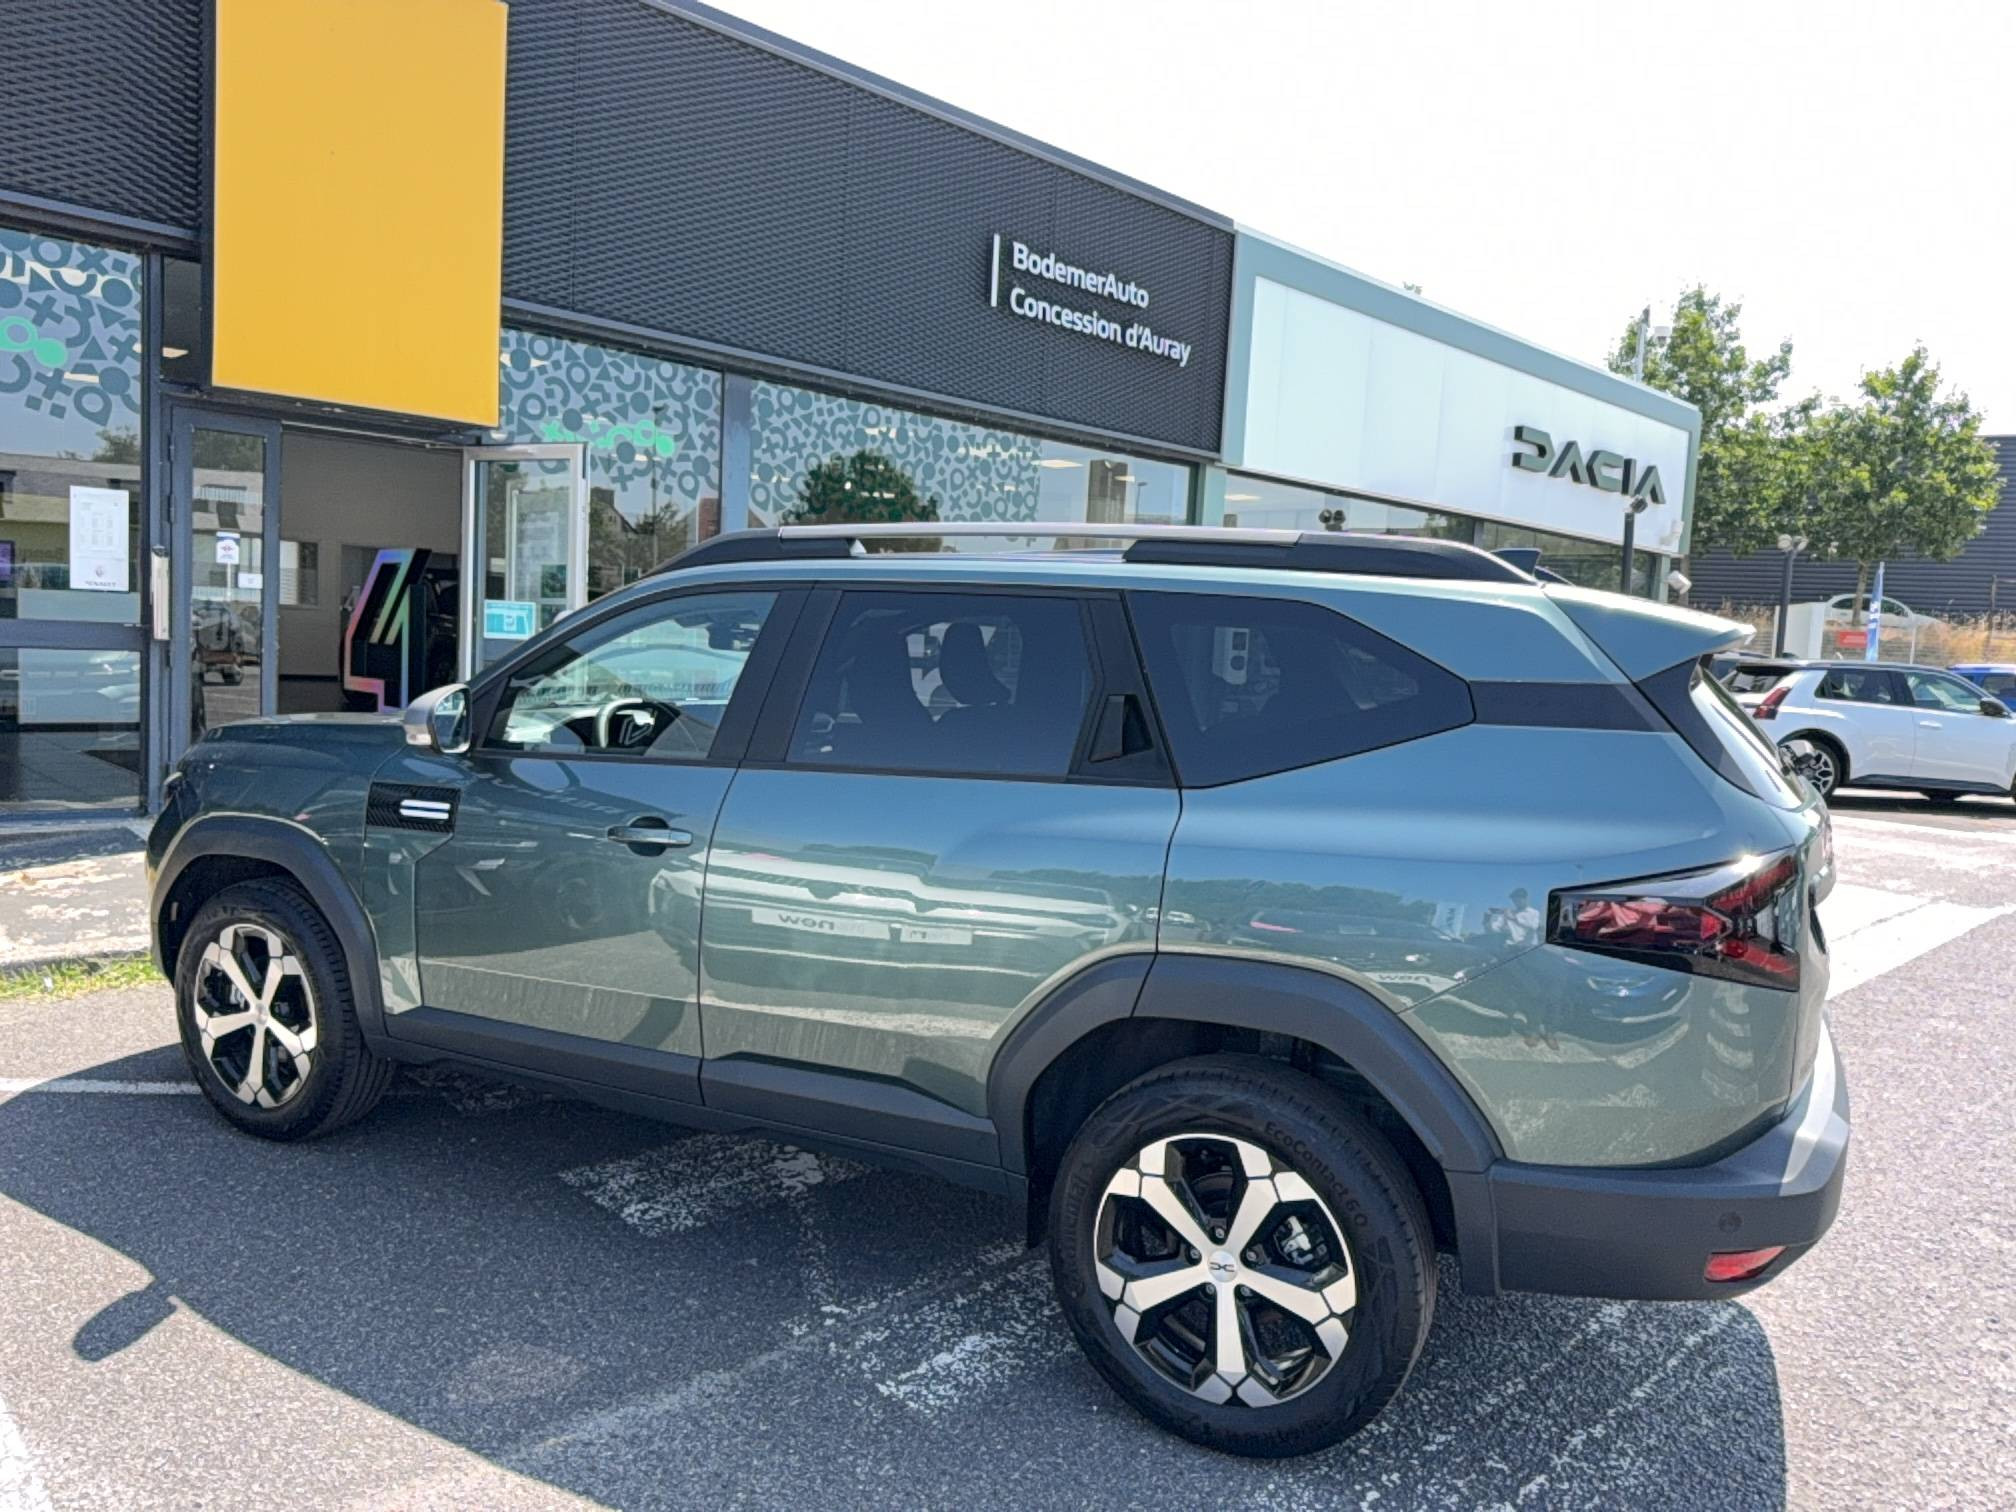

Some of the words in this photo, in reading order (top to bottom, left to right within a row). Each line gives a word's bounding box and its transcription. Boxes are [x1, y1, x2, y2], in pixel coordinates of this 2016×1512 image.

[1012, 241, 1150, 309] BodemerAuto
[1010, 287, 1123, 343] Concession
[1125, 322, 1192, 368] d'Auray
[1512, 425, 1667, 505] DACIA
[1264, 1120, 1349, 1198] EcoContact
